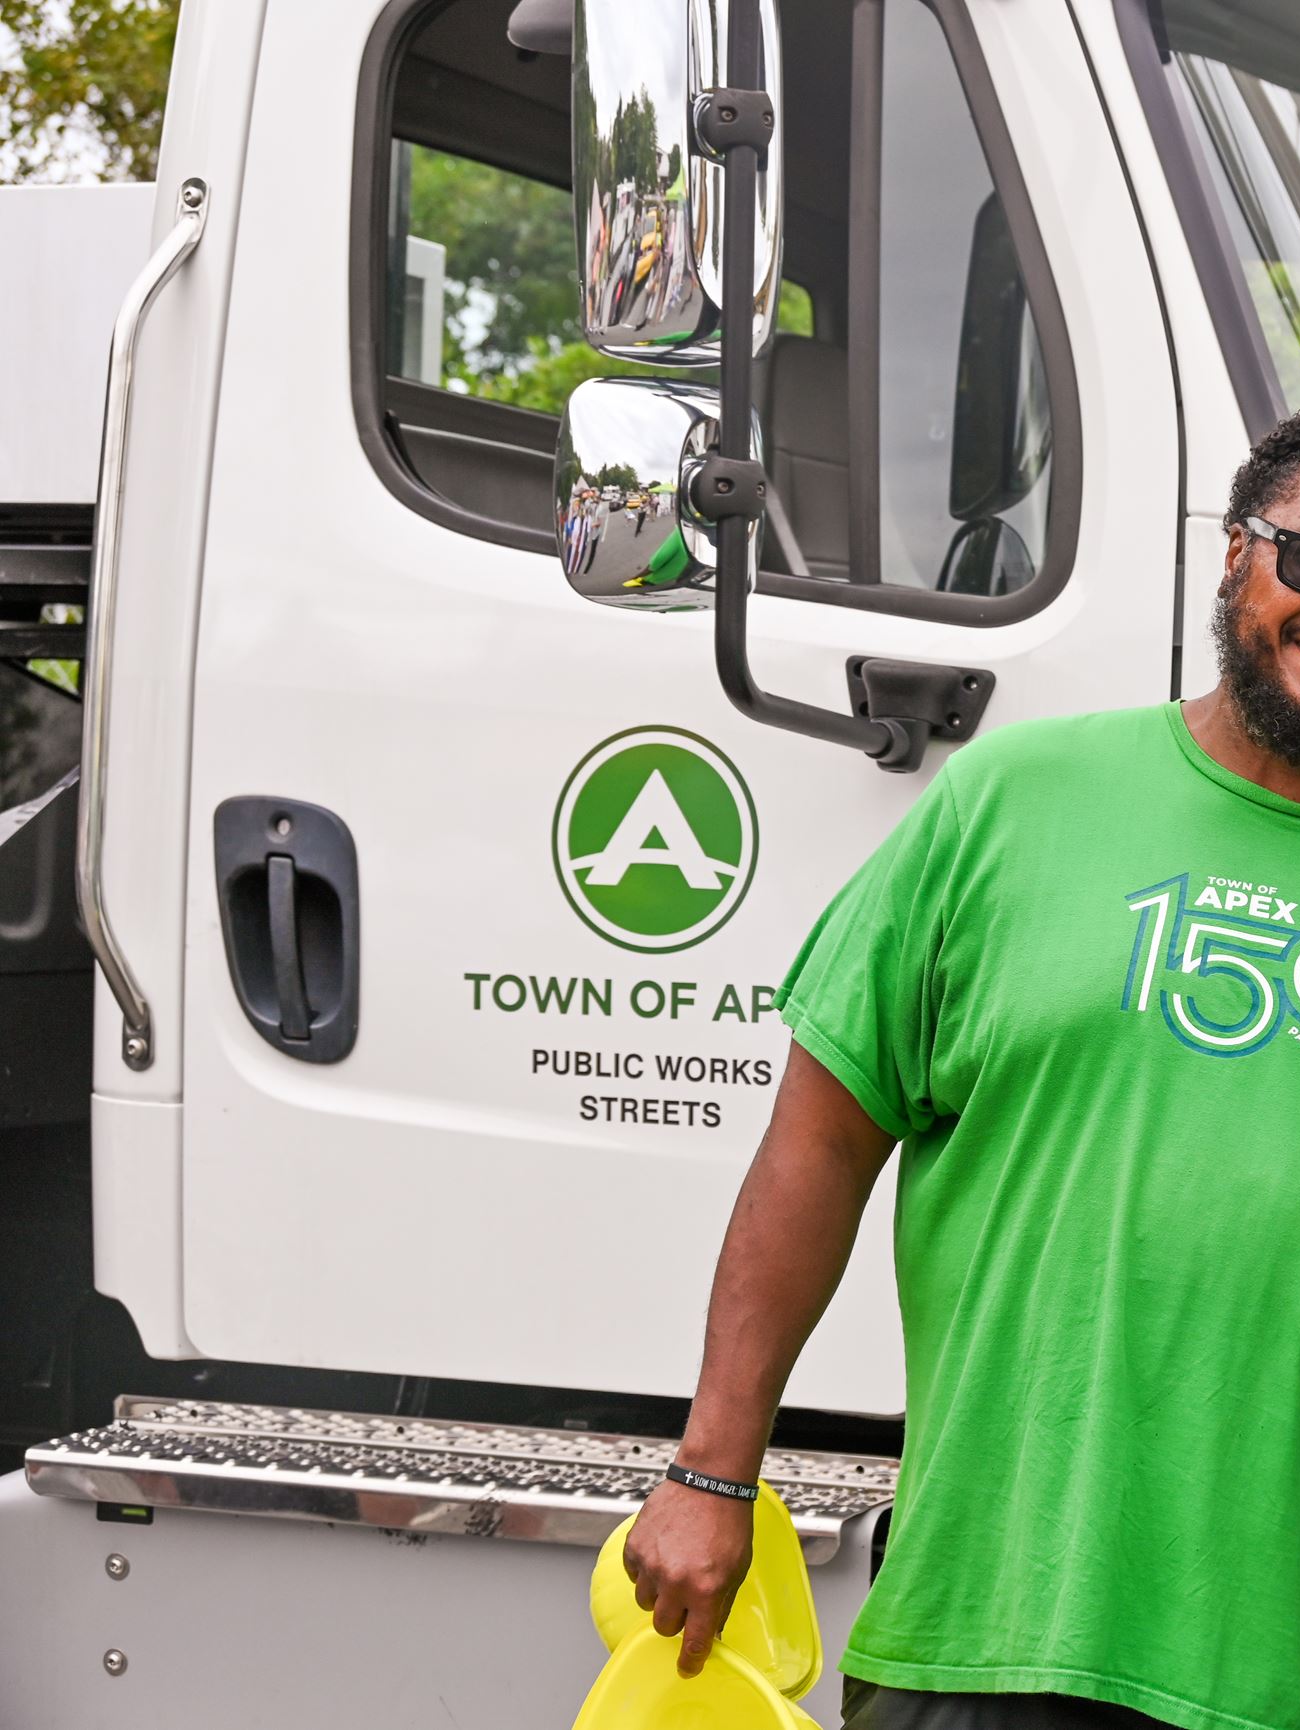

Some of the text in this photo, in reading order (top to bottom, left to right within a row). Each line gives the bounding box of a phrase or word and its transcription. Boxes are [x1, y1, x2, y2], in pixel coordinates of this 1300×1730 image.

[1207, 876, 1278, 895] TOWN OF
[1194, 886, 1298, 925] APEX
[463, 972, 777, 1024] TOWN OF AP
[531, 1049, 773, 1087] PUBLIC WORKS
[578, 1096, 722, 1128] STREETS
[693, 1475, 709, 1488] SLOW
[709, 1480, 717, 1491] TO
